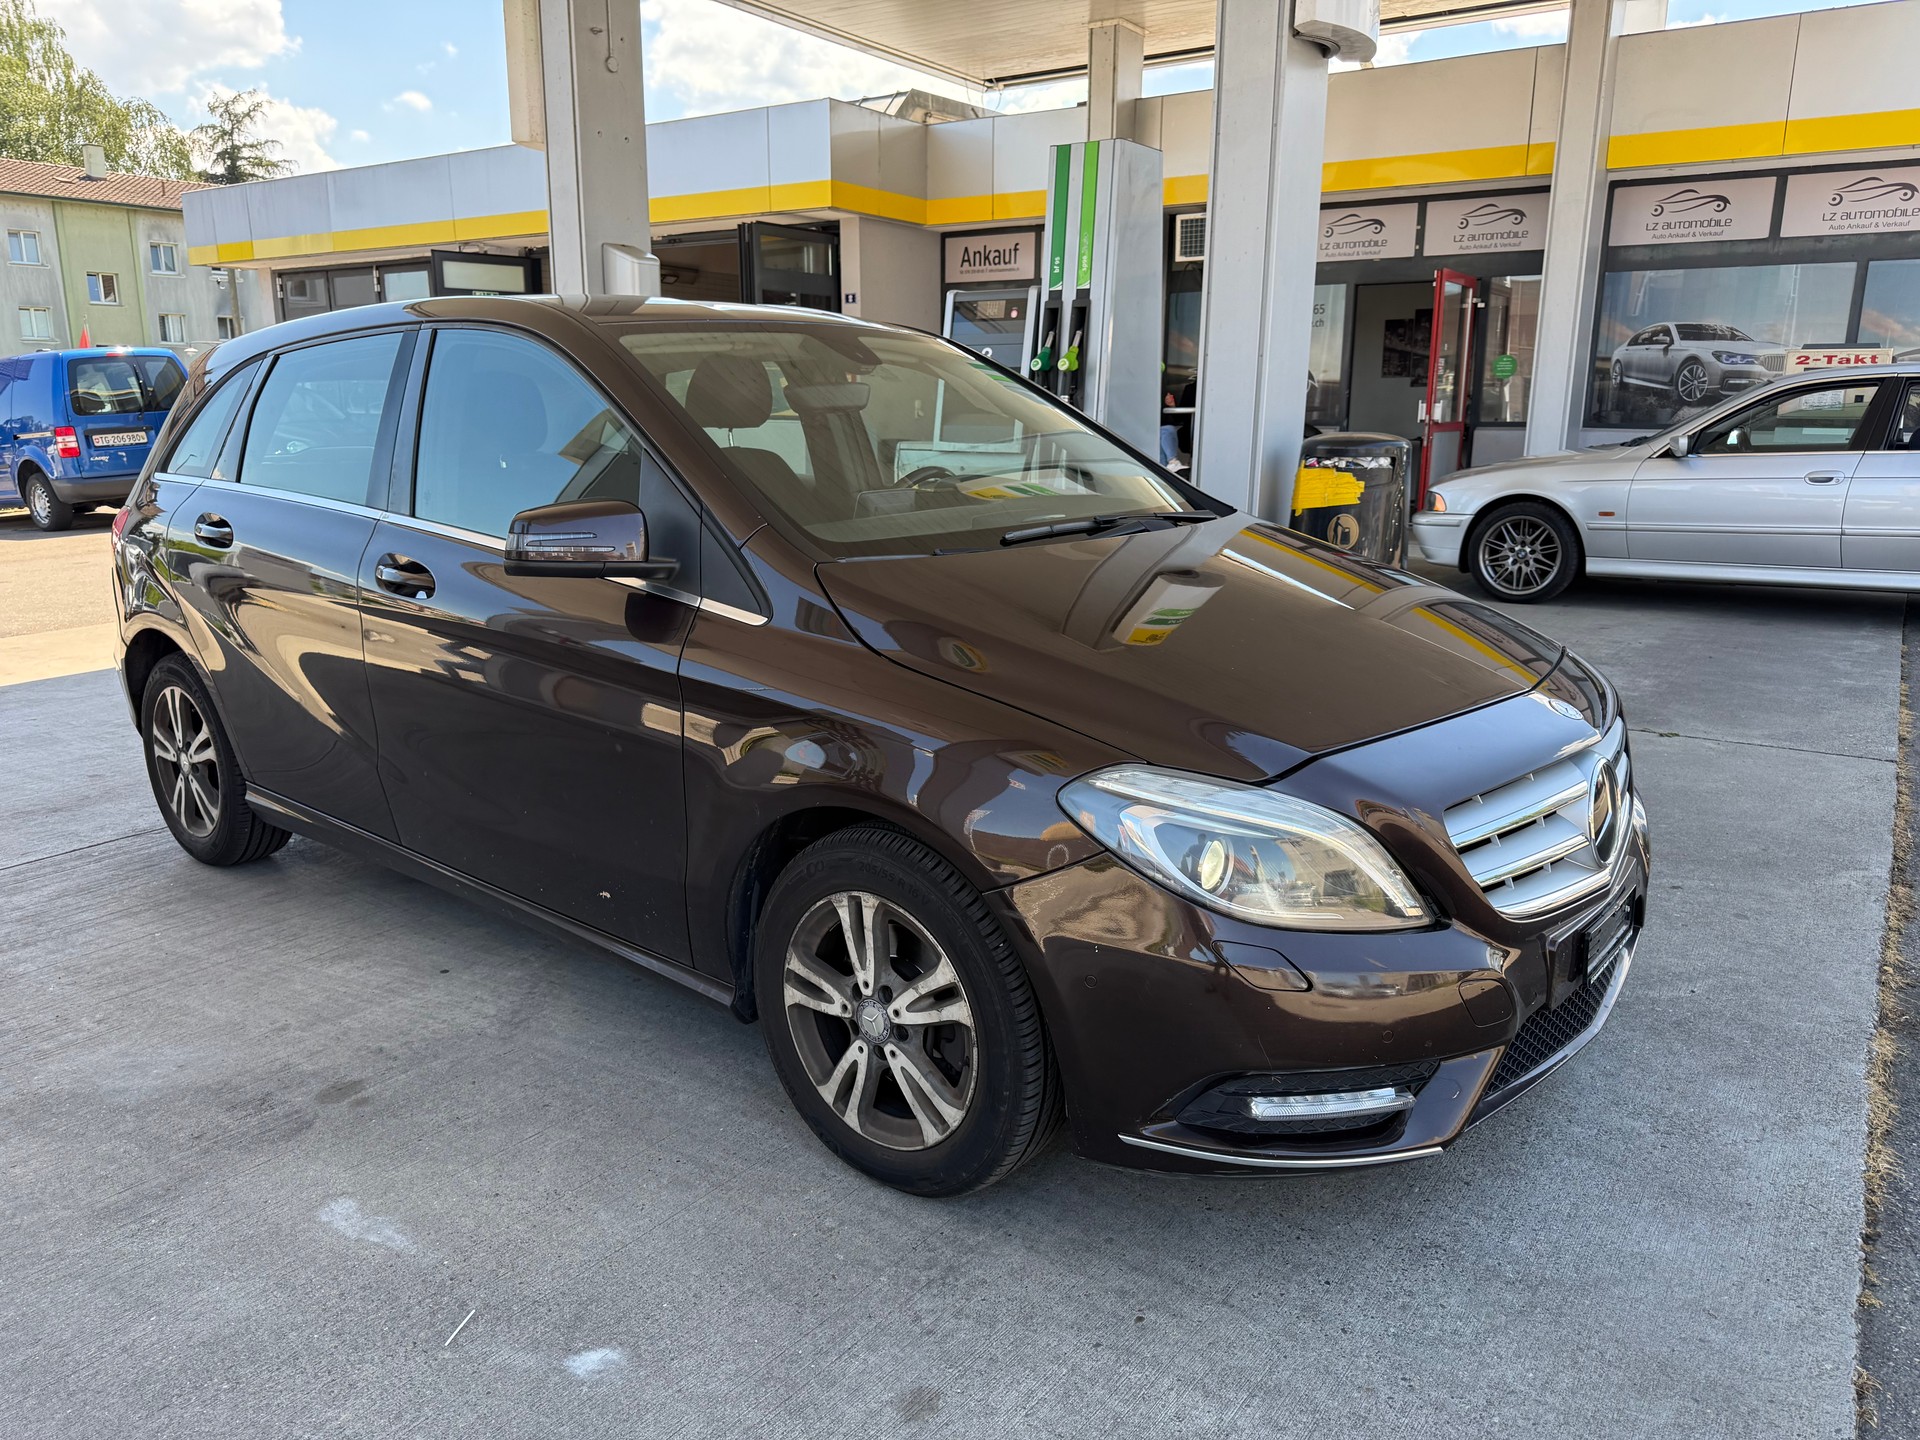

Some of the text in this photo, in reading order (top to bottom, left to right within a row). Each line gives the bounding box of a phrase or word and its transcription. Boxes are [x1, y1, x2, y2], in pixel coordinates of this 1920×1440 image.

[1822, 212, 1837, 221] LZ
[1645, 222, 1659, 231] LZ
[1846, 222, 1873, 230] Ankauf
[1882, 220, 1911, 228] Verkauf
[960, 242, 1020, 268] Ankauf
[1795, 354, 1879, 365] 2-Takt
